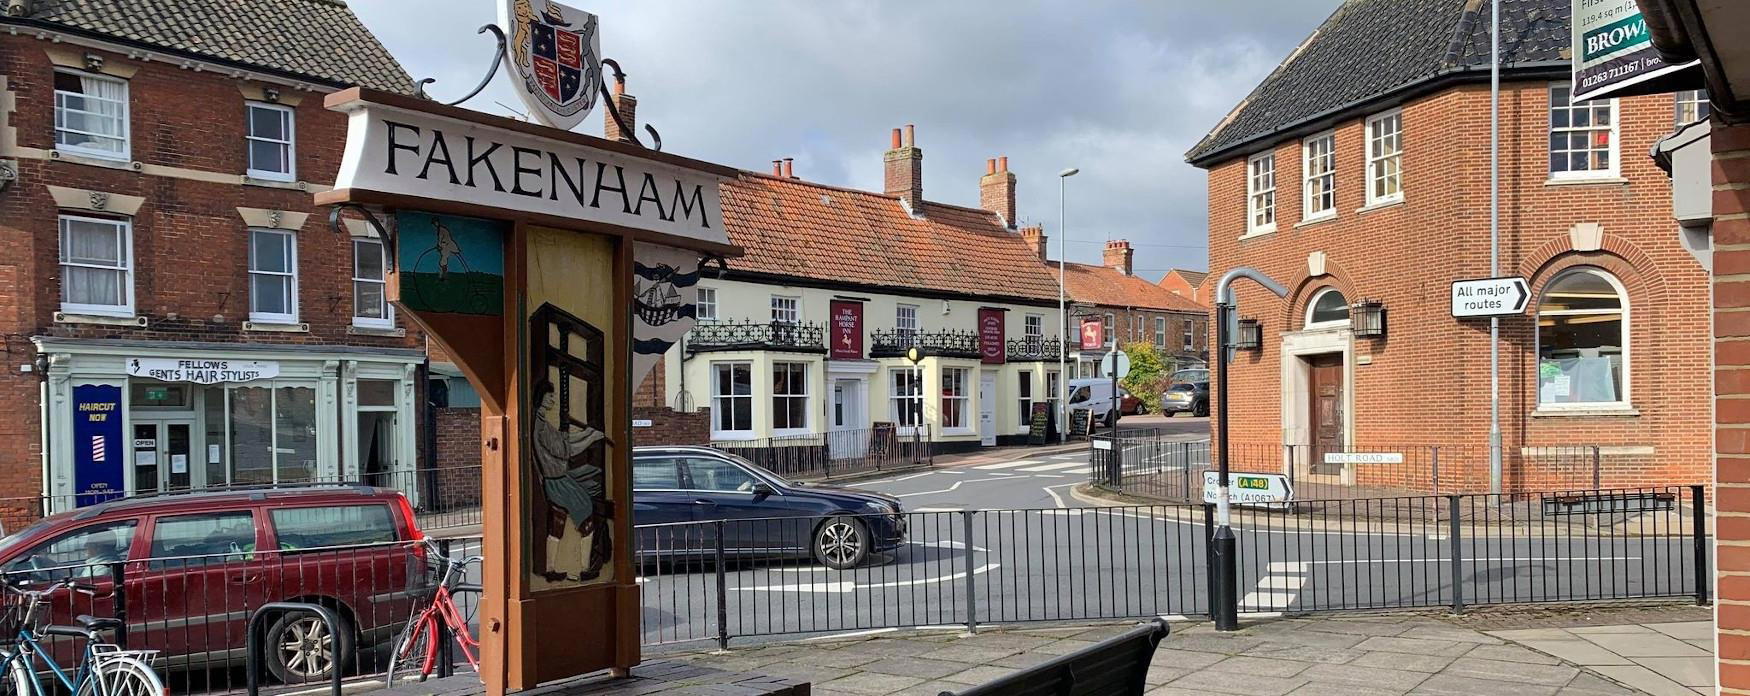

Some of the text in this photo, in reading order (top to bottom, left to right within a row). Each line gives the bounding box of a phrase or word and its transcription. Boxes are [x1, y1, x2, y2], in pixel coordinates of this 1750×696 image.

[1582, 12, 1602, 26] 119.4
[1604, 9, 1613, 18] sq
[1615, 5, 1623, 14] m
[1582, 71, 1608, 87] 01263
[1609, 60, 1639, 79] 711167
[382, 119, 710, 229] FAKENHAM
[1457, 284, 1511, 297] All major
[1464, 299, 1502, 310] routes
[178, 360, 228, 370] FELLOWS
[149, 369, 260, 383] GENTS HAIR STYLISTS
[79, 403, 116, 411] HAIRCUT
[89, 413, 108, 422] NOW
[1327, 454, 1352, 462] HOLT
[1355, 454, 1383, 462] ROAD
[1207, 476, 1234, 486] Croer
[1206, 490, 1276, 502] Noch (A1067)
